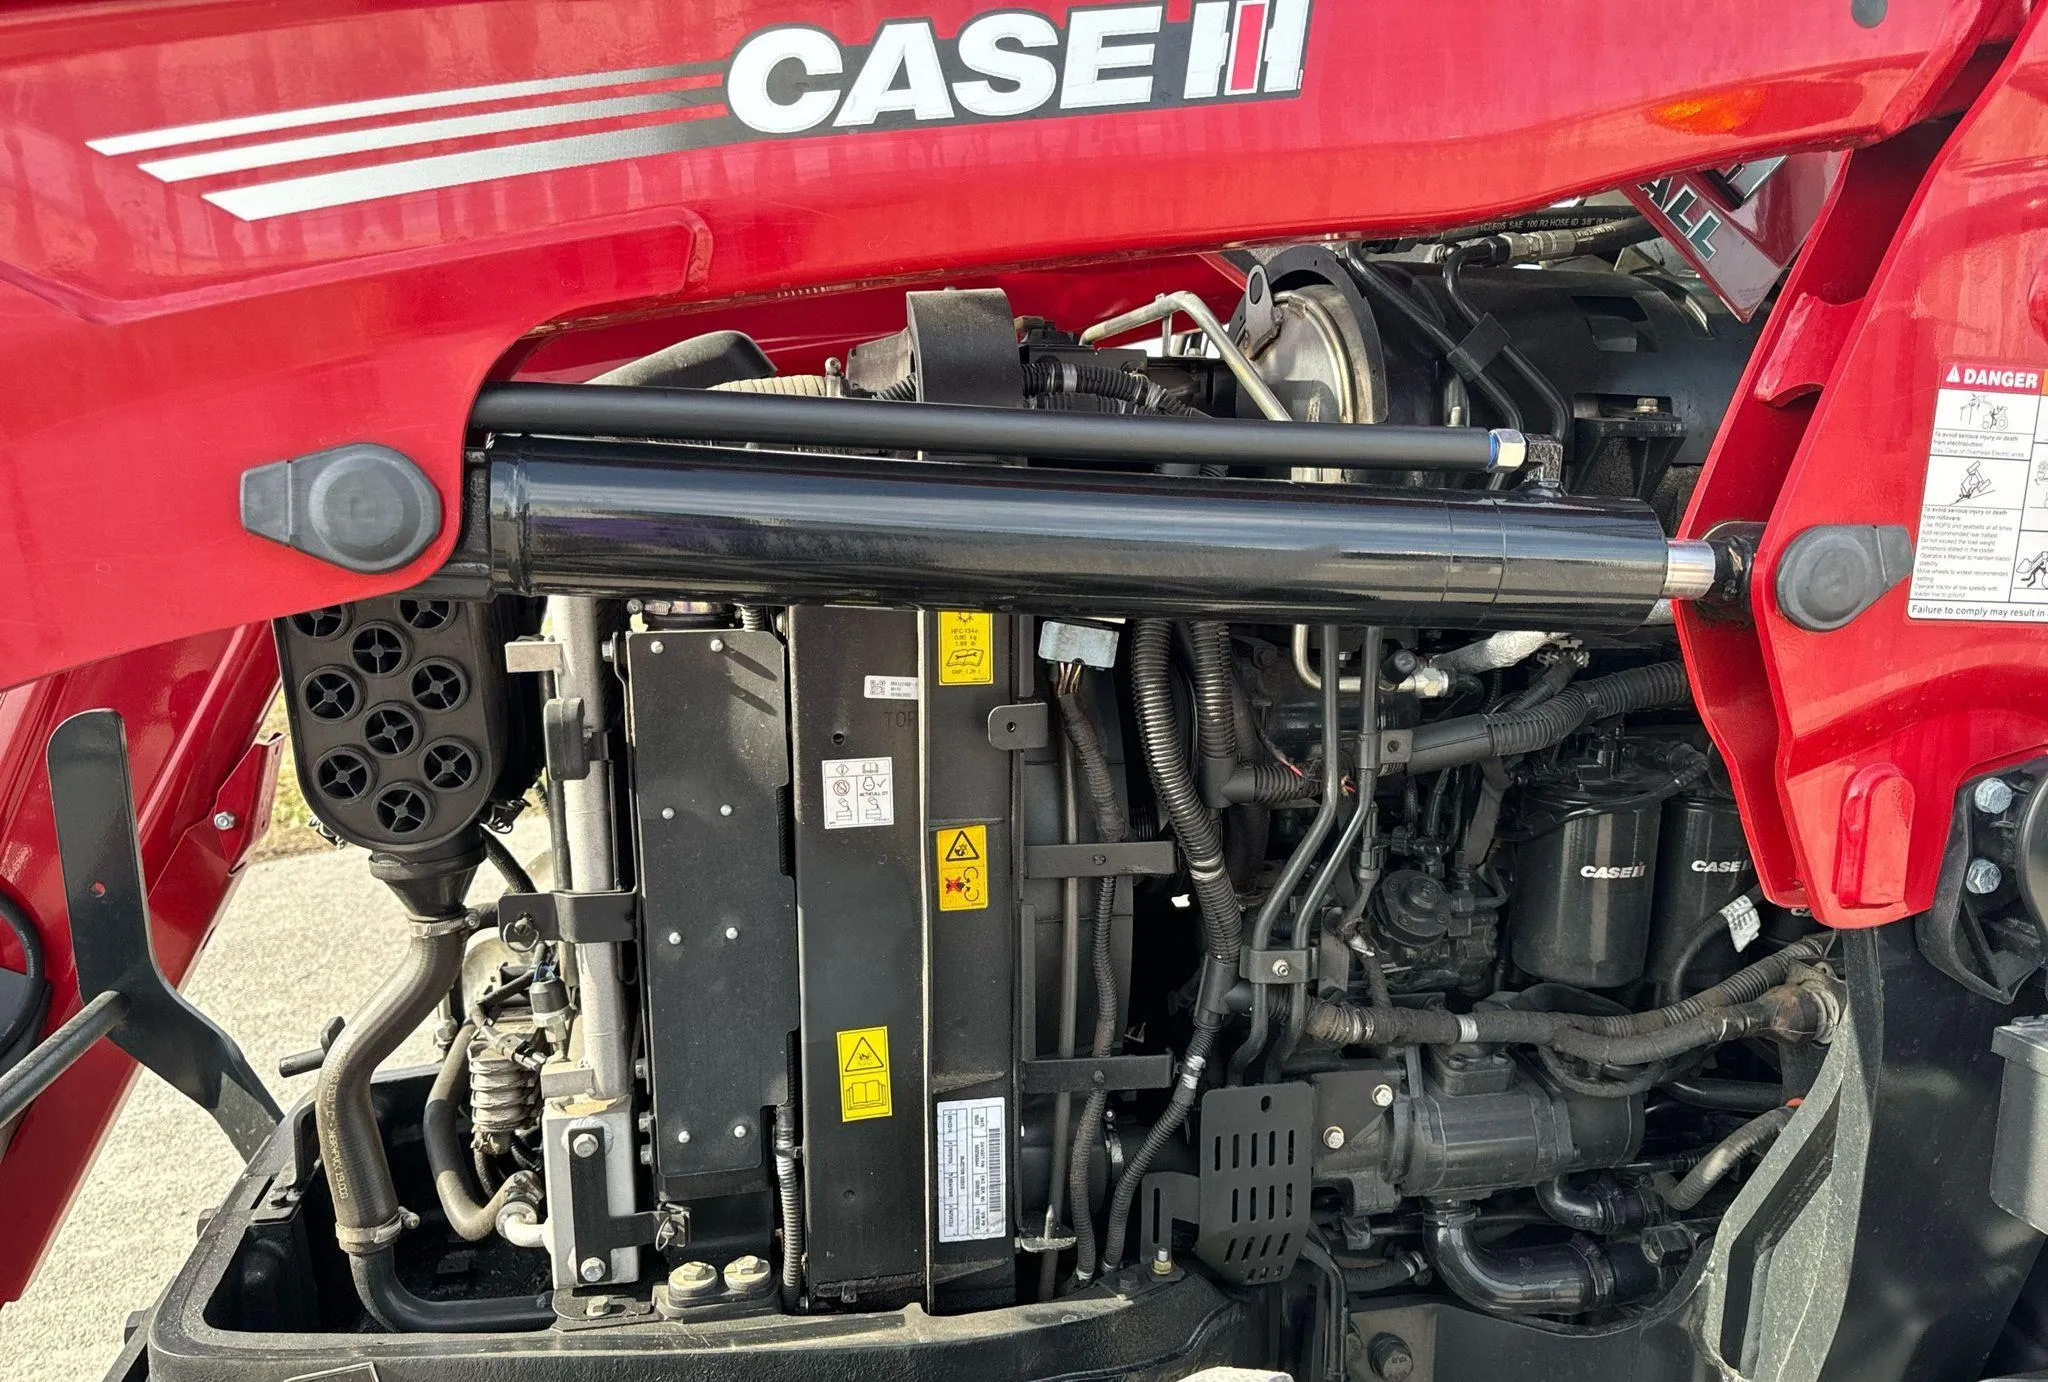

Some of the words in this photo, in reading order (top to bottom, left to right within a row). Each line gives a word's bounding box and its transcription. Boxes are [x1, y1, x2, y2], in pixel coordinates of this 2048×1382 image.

[726, 5, 1163, 134] CASE
[1509, 220, 1524, 229] SAE
[1550, 218, 1570, 227] HOSE
[1963, 368, 2039, 389] DANGER
[1912, 604, 1942, 614] Failure
[1956, 607, 1987, 617] comply
[1990, 609, 2008, 617] may
[2010, 608, 2035, 617] result
[1580, 866, 1632, 878] CASE
[1692, 860, 1741, 872] CASE
